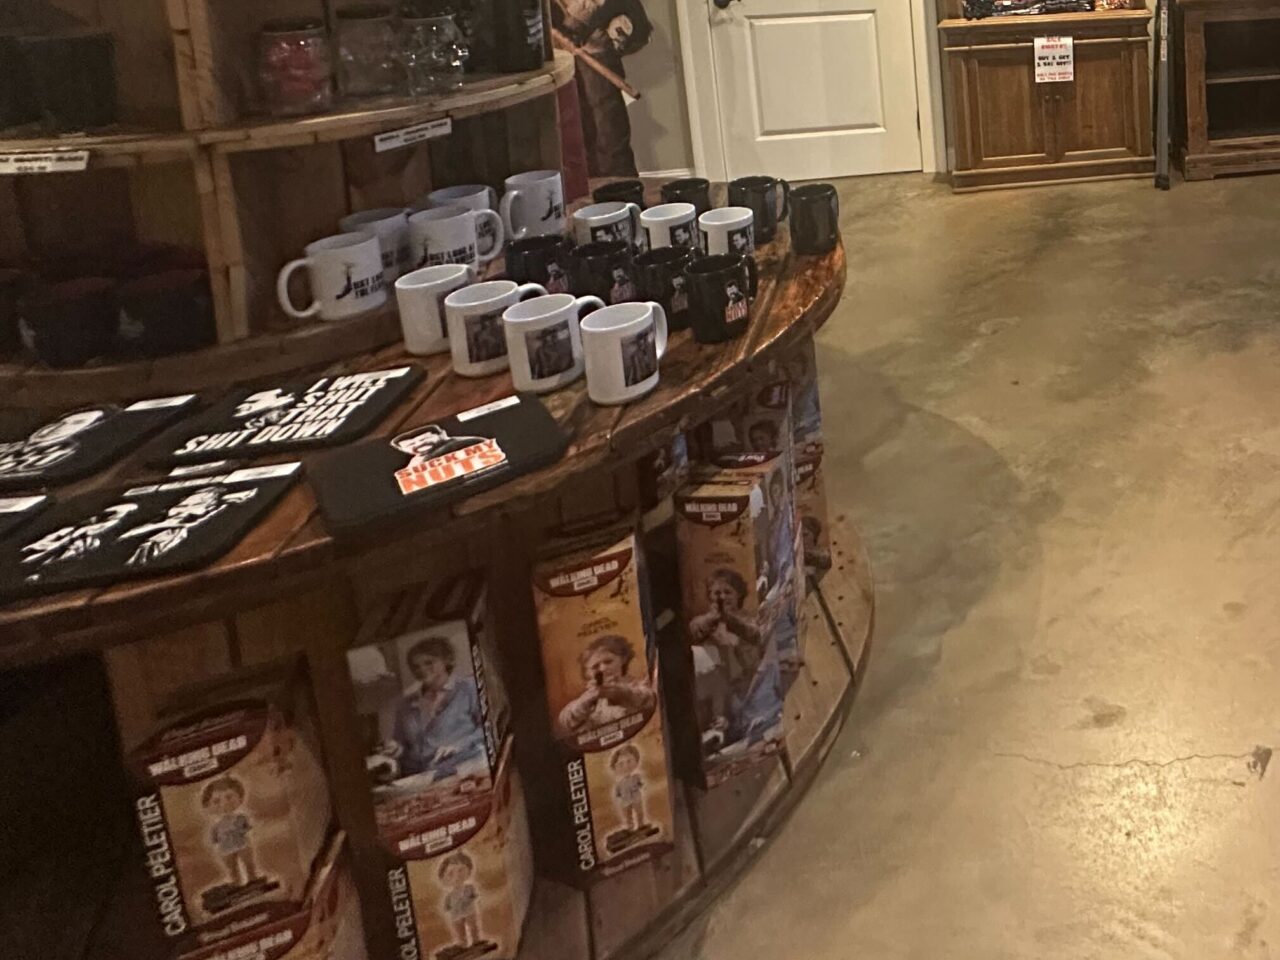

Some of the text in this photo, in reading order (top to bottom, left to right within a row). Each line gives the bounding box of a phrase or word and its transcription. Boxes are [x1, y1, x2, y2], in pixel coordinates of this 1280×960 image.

[297, 387, 379, 408] SHUT
[305, 378, 328, 394] I
[276, 401, 366, 425] THAT
[173, 417, 348, 455] SHIT DOWN
[397, 440, 495, 478] SUCK MY
[400, 451, 504, 493] NUTS
[550, 559, 619, 589] WALKING DEAD
[148, 734, 248, 777] WALKING DEAD
[567, 758, 588, 825] PELETIER
[137, 792, 173, 878] PELETIER
[398, 816, 477, 851] WALKING DEAD
[576, 821, 596, 871] CAROL
[155, 875, 186, 937] CAROL
[388, 867, 415, 939] PELETIER
